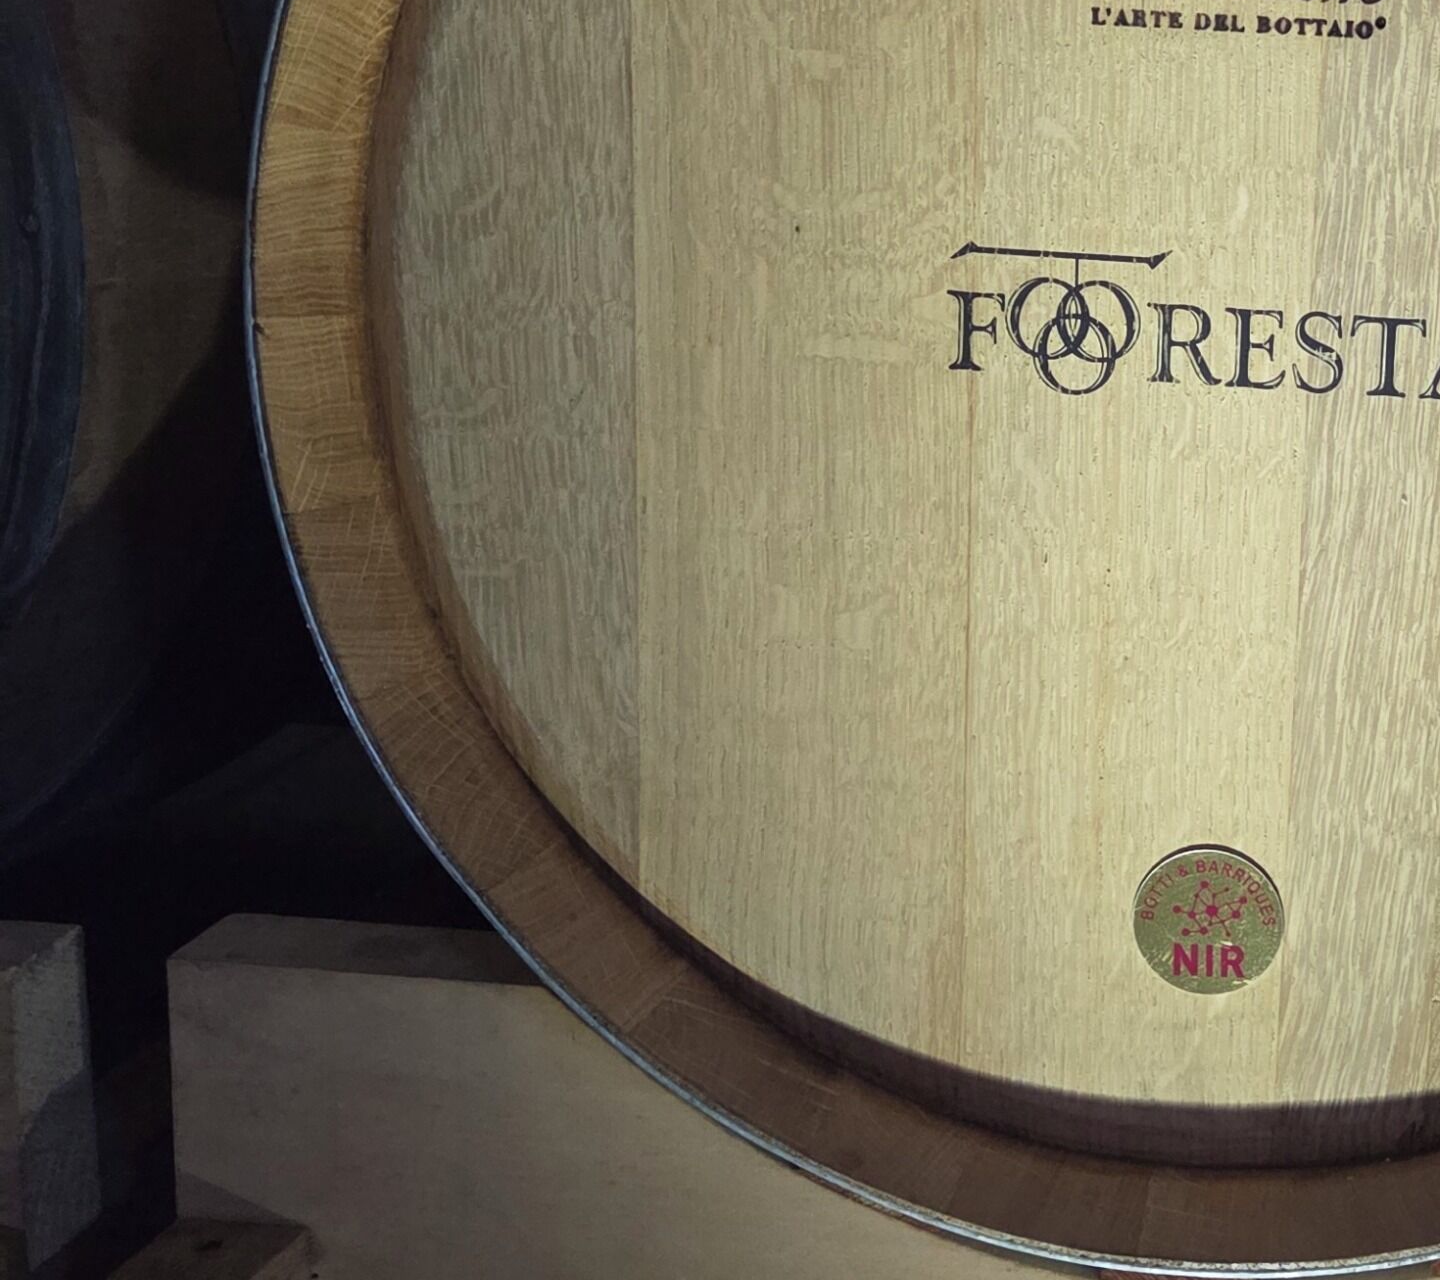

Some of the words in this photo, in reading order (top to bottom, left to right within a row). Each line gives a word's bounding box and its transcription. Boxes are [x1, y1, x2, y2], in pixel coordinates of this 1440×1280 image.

[1091, 6, 1183, 30] L'ARTE
[1194, 12, 1245, 34] DEL
[1177, 864, 1189, 877] &
[1195, 859, 1277, 927] BARRIQUES
[1172, 942, 1246, 979] NIR
